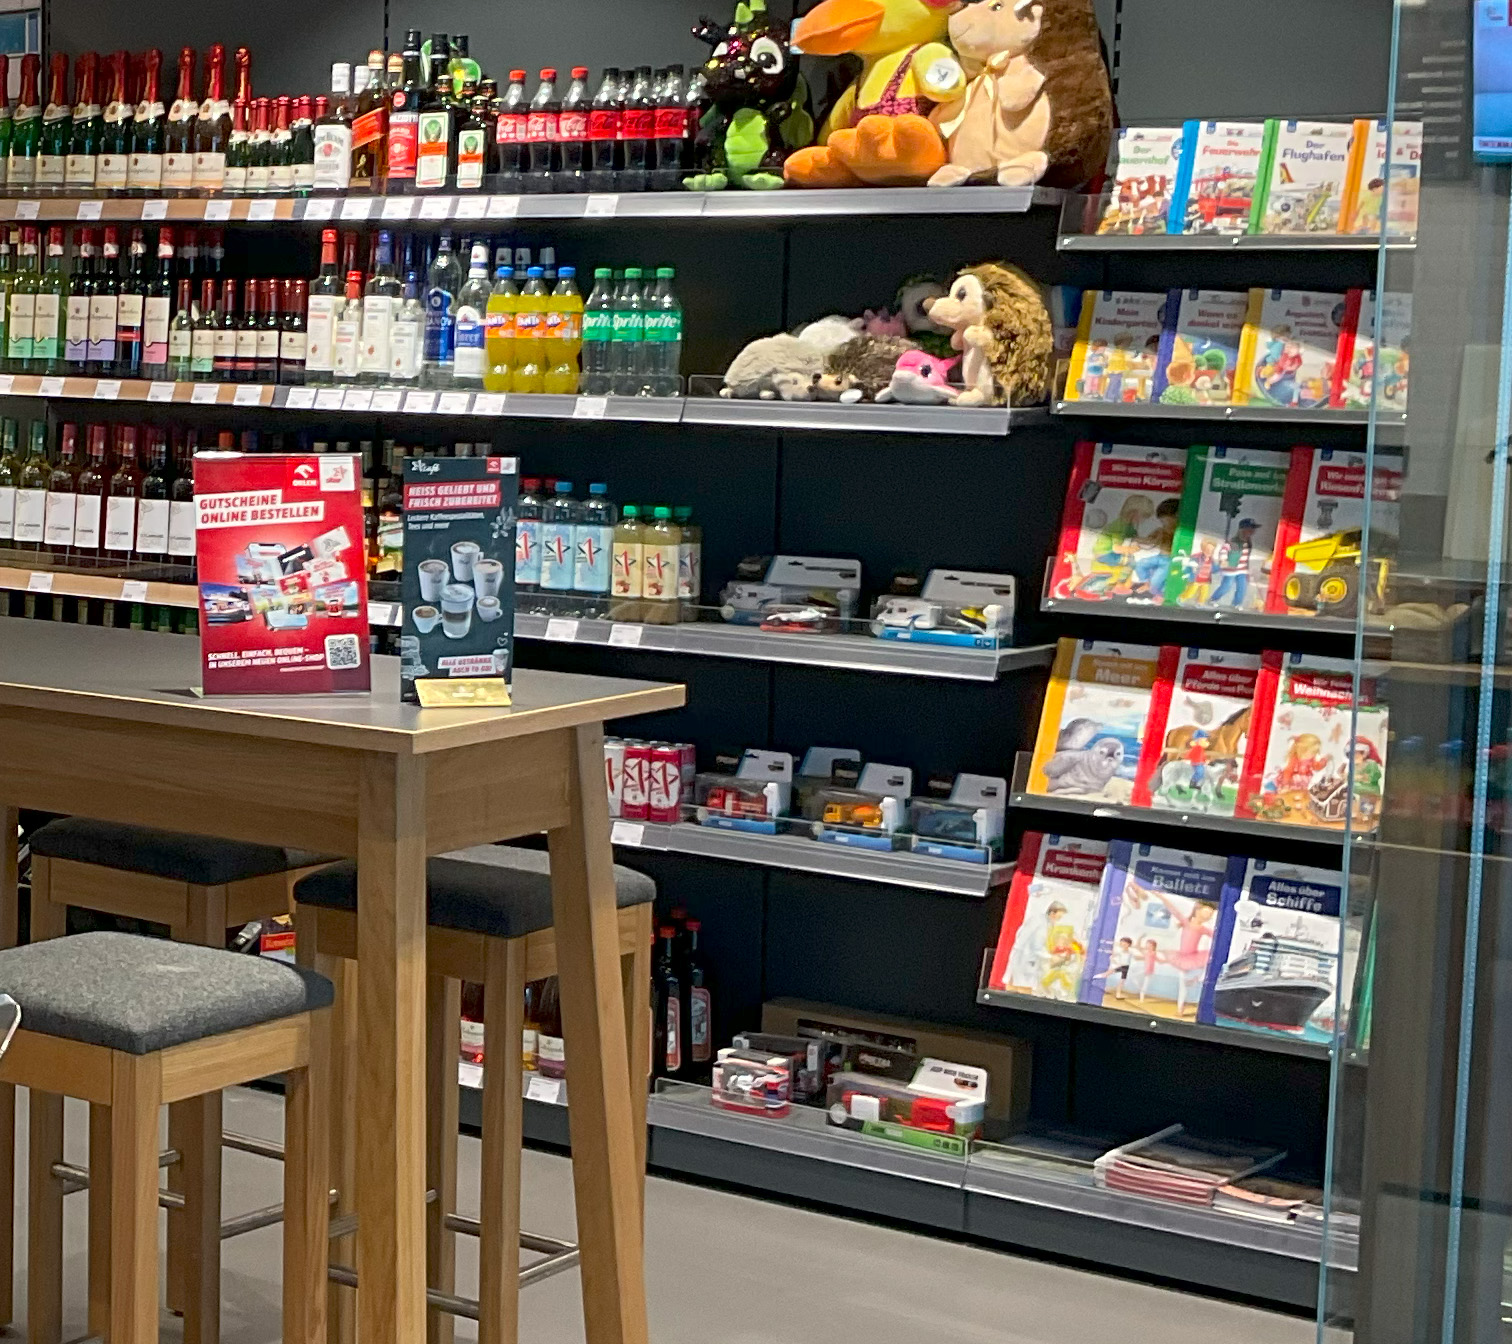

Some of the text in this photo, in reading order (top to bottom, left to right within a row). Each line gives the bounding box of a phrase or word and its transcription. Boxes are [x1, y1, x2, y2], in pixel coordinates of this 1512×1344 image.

[1282, 149, 1346, 162] Flughafen
[200, 495, 278, 510] GUTSCHEINE
[201, 506, 320, 524] ONLINE BESTELLEN
[1095, 668, 1139, 685] Meer
[1153, 875, 1210, 895] Ballett
[1268, 881, 1325, 897] Alles über
[1265, 893, 1323, 912] Schiffe
